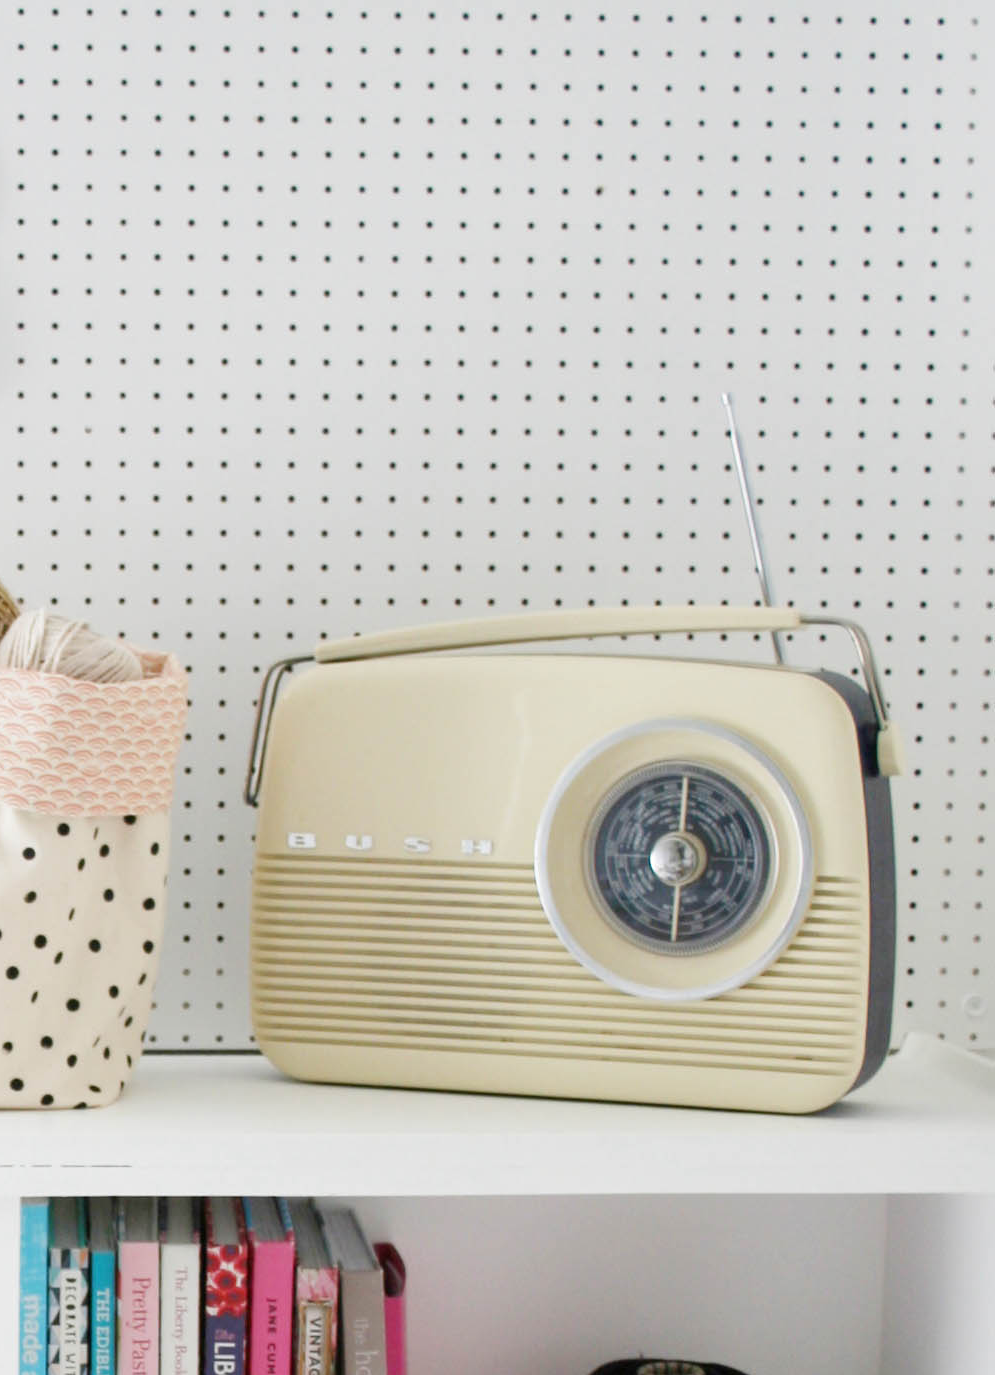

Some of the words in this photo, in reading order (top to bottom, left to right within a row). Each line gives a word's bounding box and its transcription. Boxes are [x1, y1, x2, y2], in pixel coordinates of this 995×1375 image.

[288, 832, 493, 856] BUSH
[175, 1267, 189, 1292] The
[64, 1277, 77, 1345] DECORATE
[96, 1288, 110, 1322] THE
[125, 1278, 152, 1337] Pretty
[171, 1297, 188, 1340] Liberty
[266, 1298, 277, 1334] JANE
[22, 1295, 42, 1364] made
[355, 1319, 370, 1345] the
